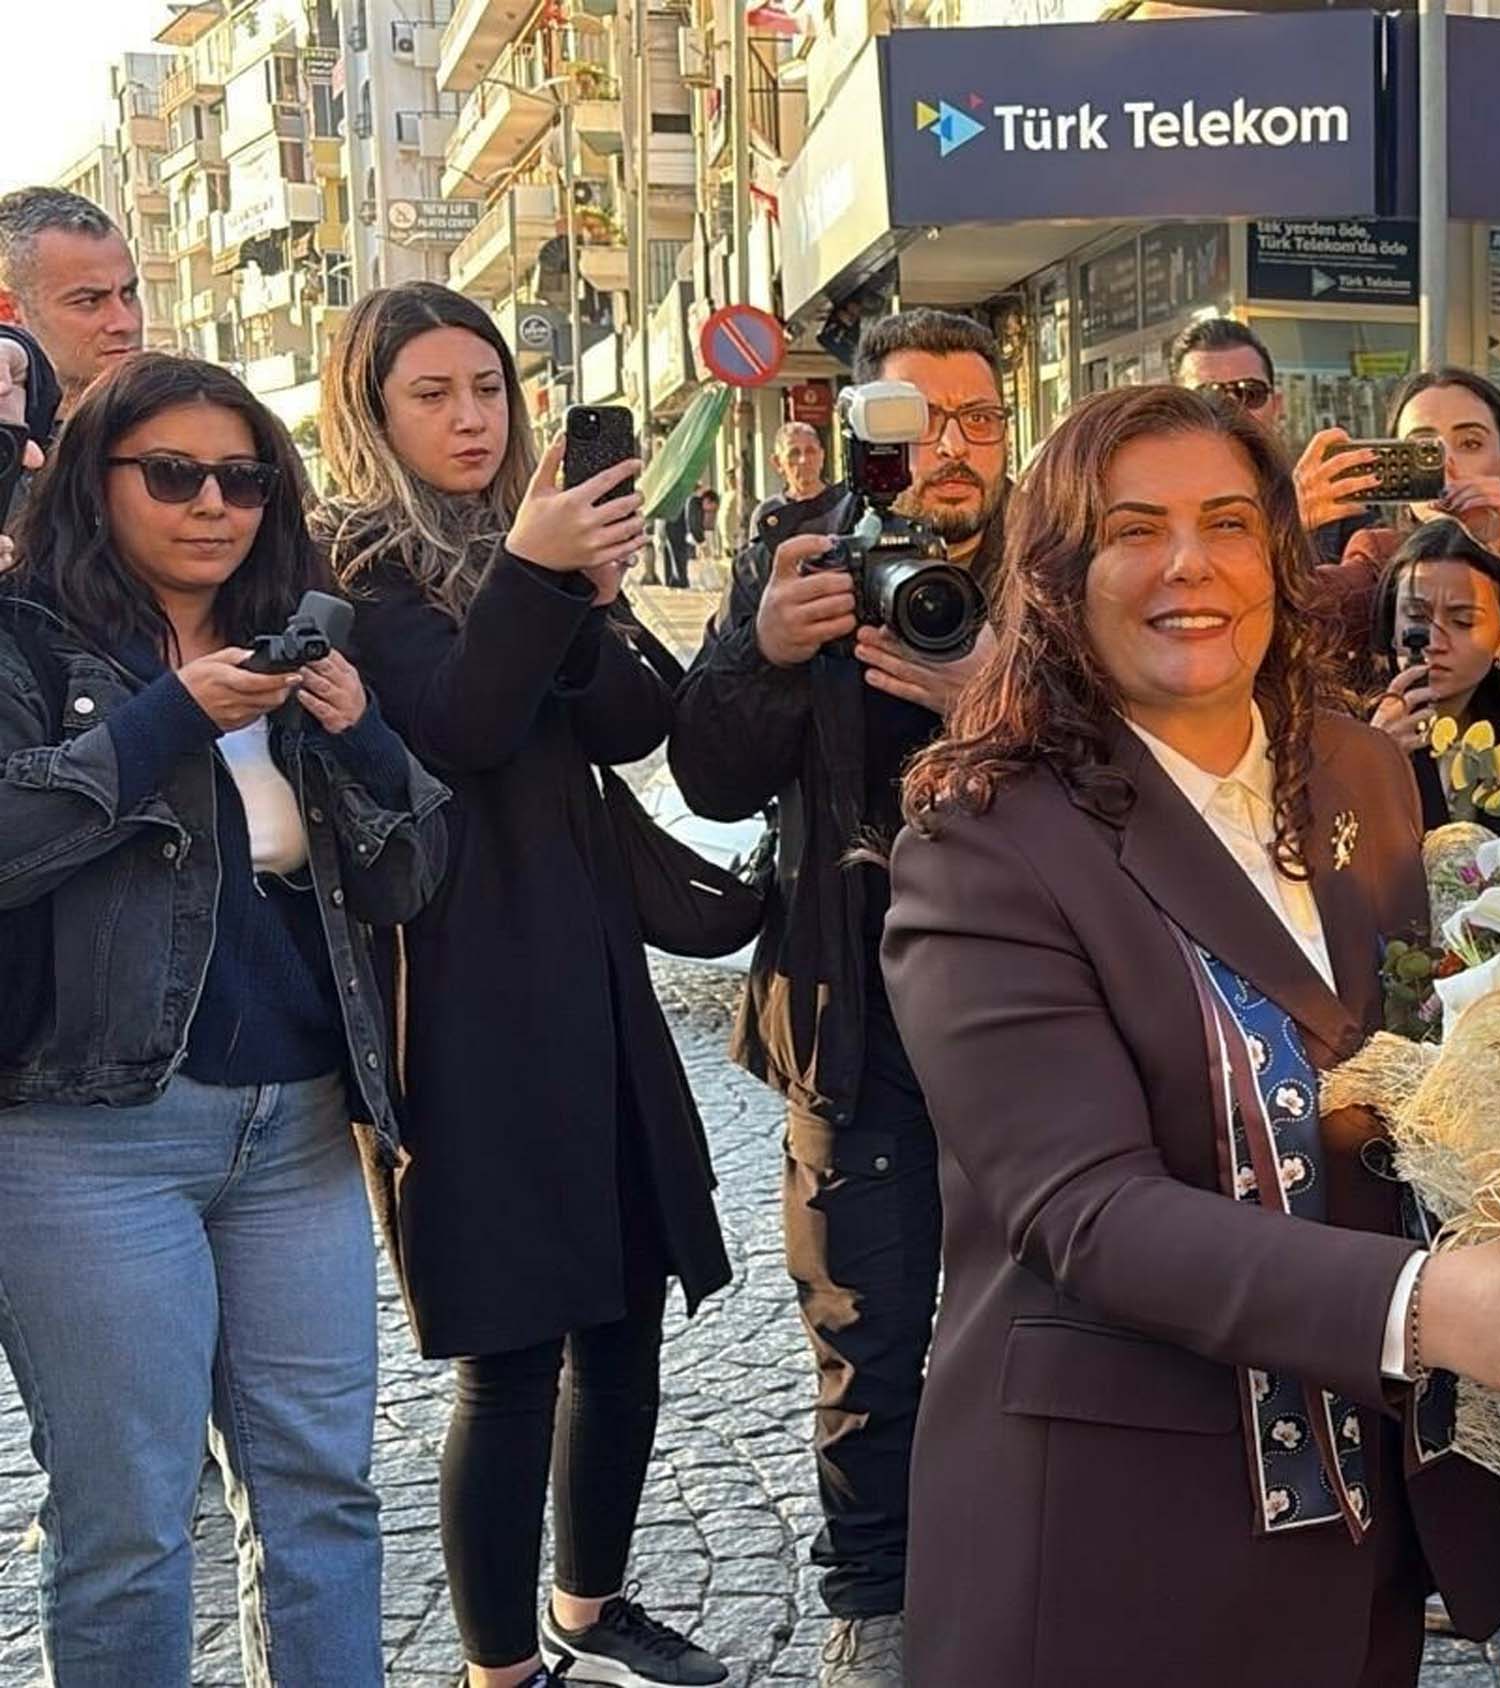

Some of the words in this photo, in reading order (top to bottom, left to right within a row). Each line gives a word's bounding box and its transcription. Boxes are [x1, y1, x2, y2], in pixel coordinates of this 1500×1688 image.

[994, 103, 1108, 151] Türk
[1124, 98, 1348, 147] Telekom
[1285, 223, 1336, 237] yerden
[1258, 235, 1291, 251] Türk
[1379, 241, 1409, 256] öde
[880, 535, 910, 545] Nikon
